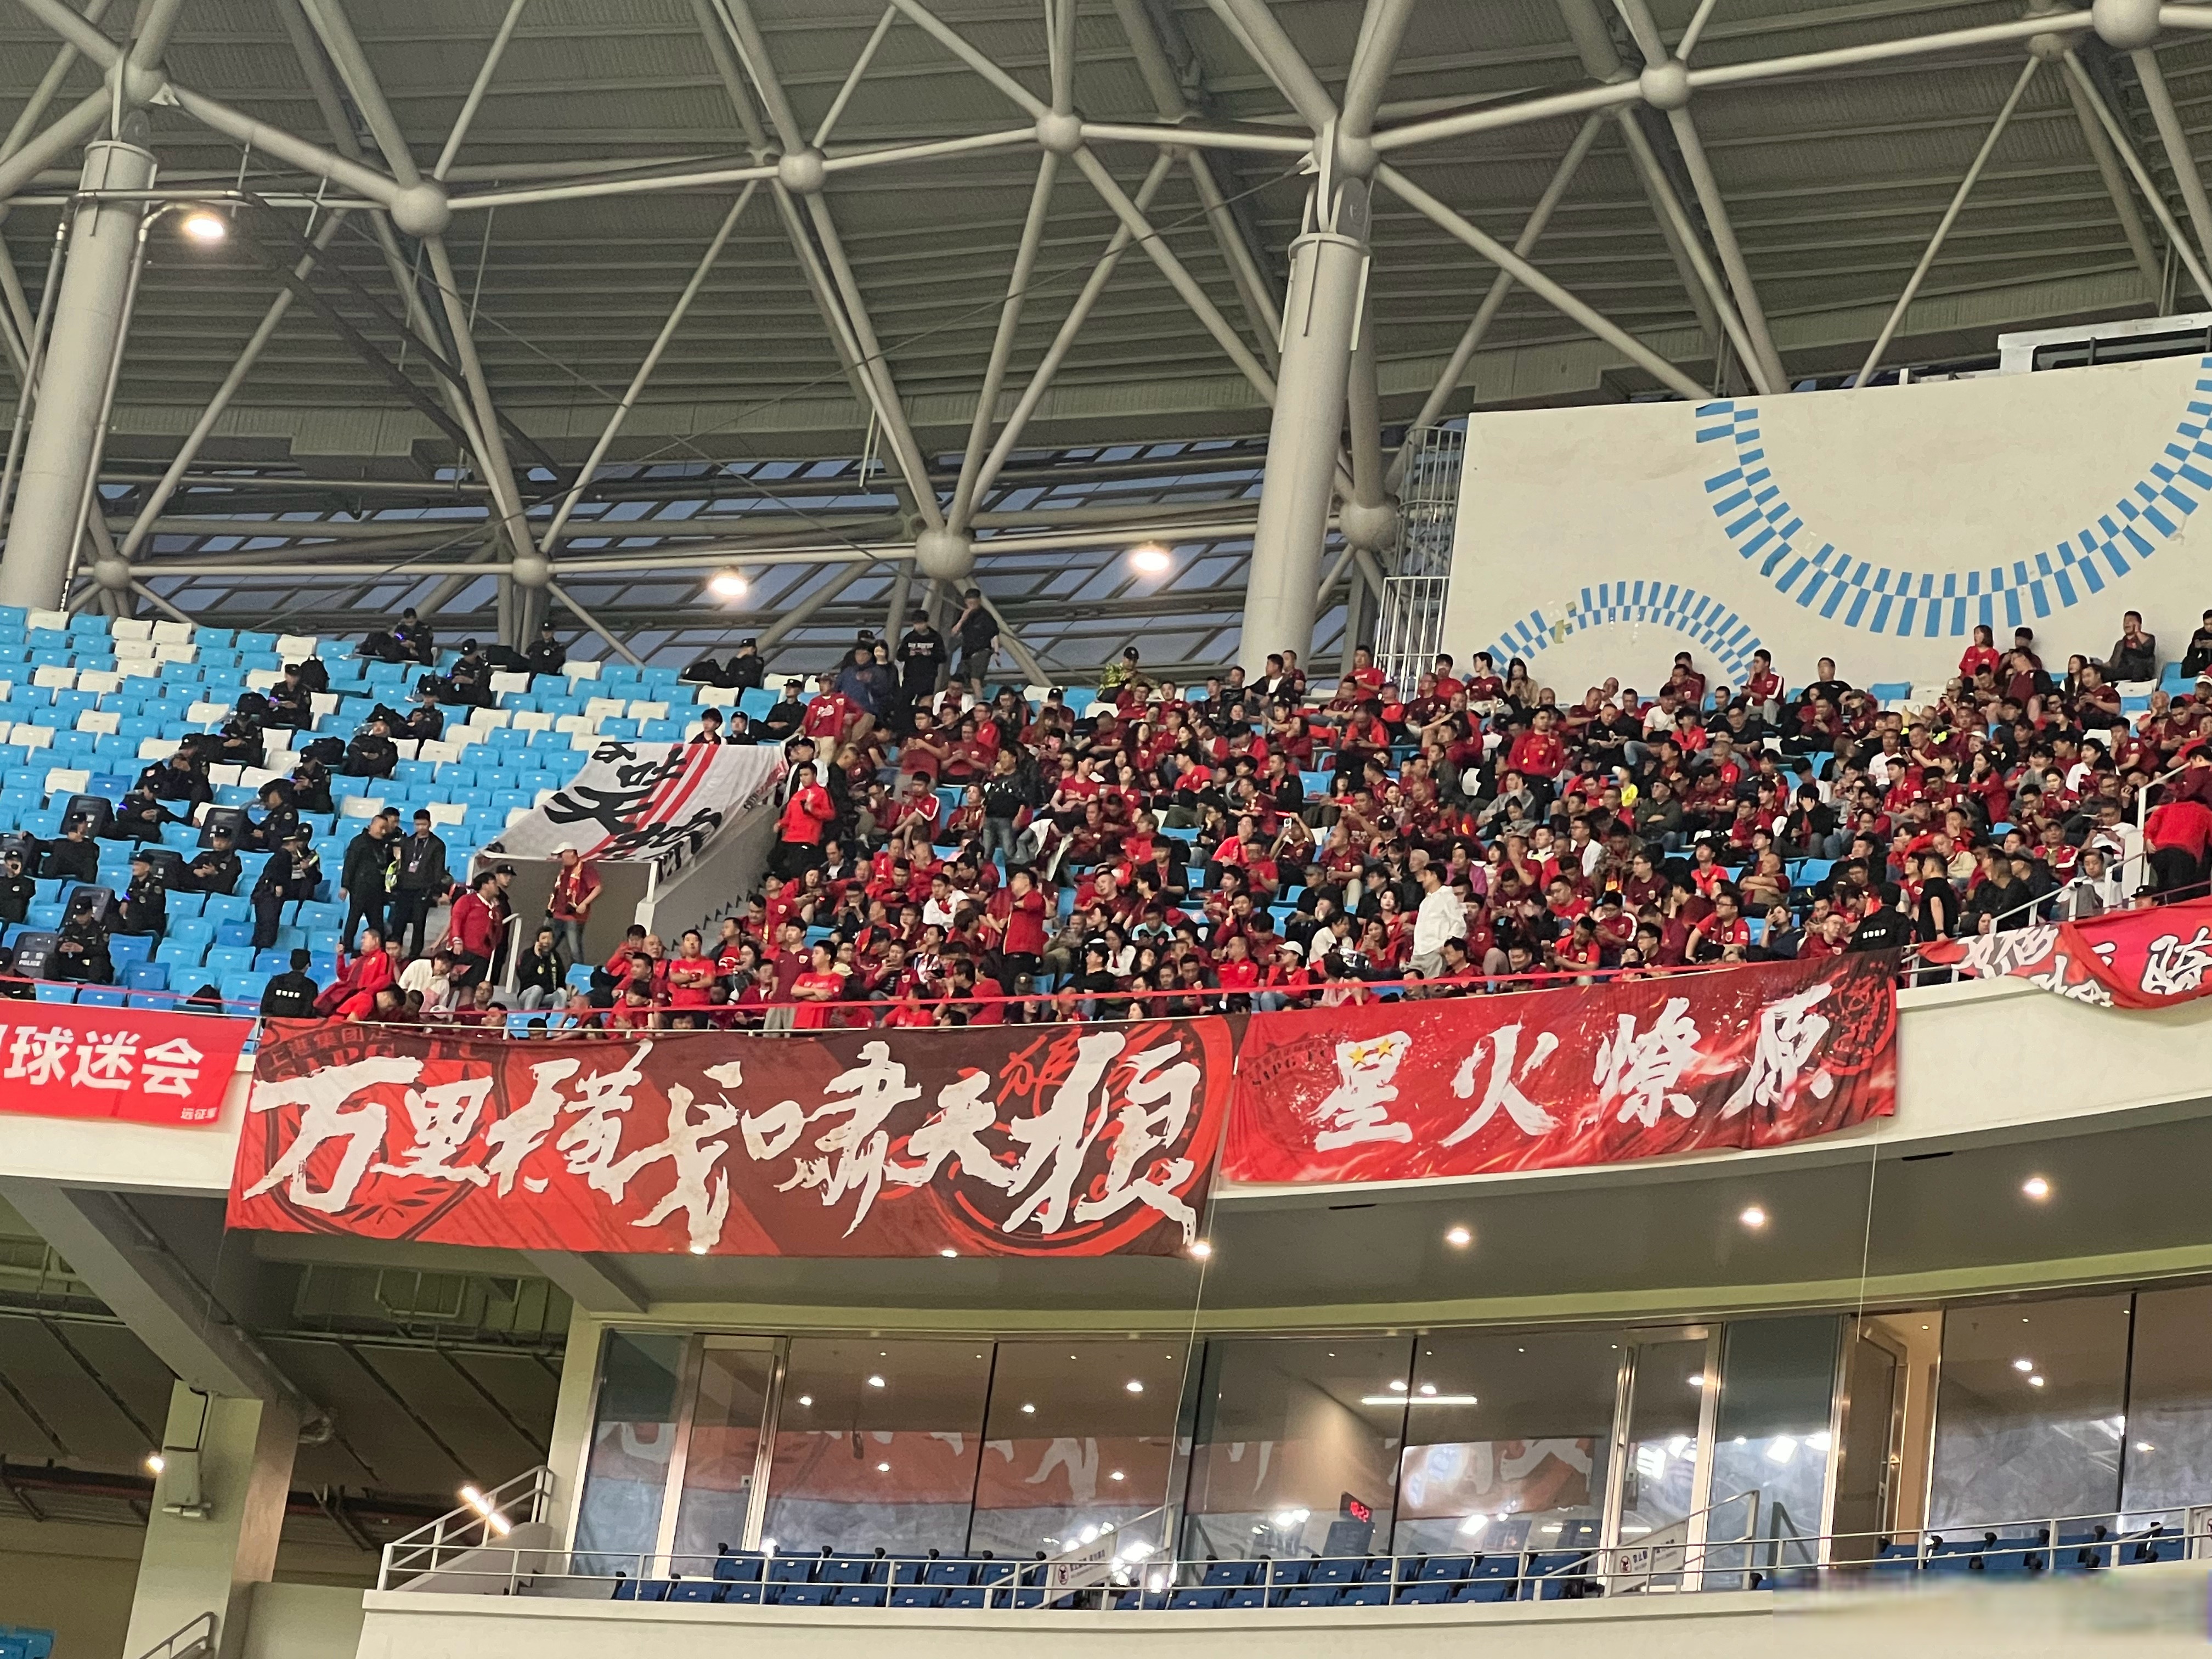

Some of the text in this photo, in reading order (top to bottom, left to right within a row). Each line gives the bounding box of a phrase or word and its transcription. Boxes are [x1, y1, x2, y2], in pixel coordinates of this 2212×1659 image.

[0, 1024, 205, 1099] 球迷会
[1308, 982, 1833, 1153] 星火燎原
